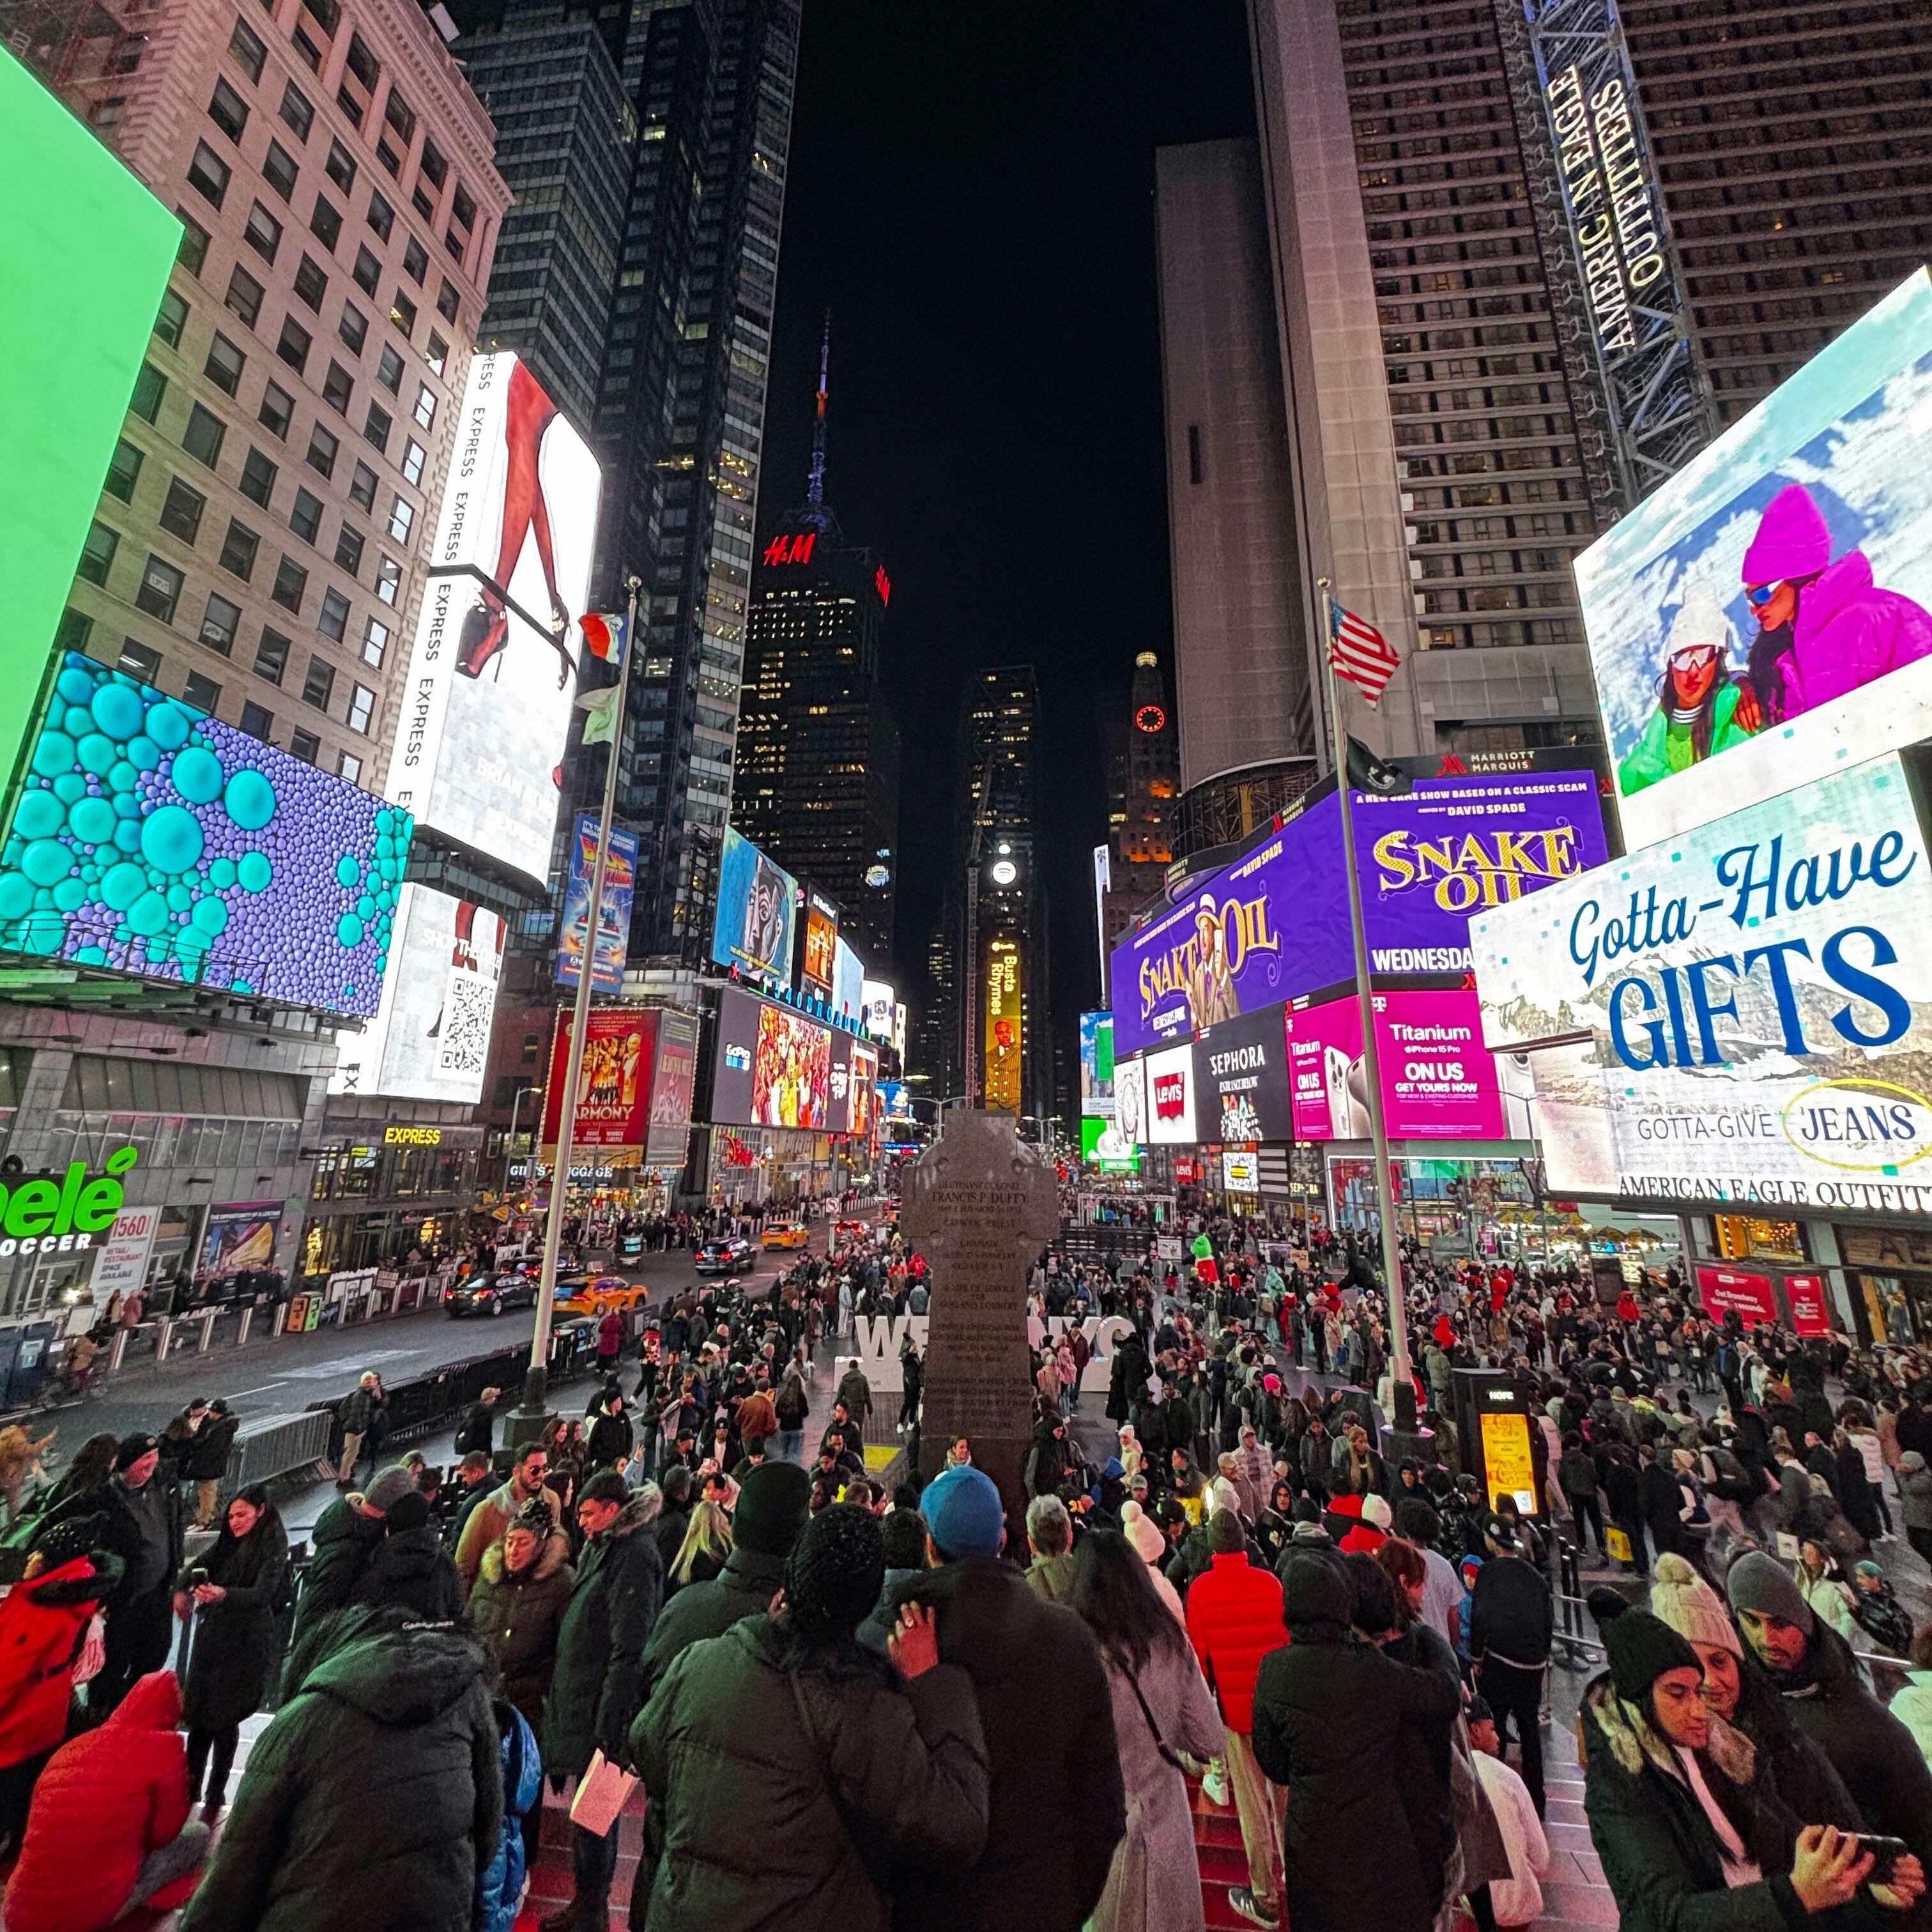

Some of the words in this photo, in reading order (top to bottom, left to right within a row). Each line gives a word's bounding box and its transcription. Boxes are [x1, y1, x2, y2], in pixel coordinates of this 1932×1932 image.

[1548, 65, 1595, 174] EAGLE
[1591, 79, 1664, 289] OUTFITTERS
[1568, 168, 1636, 352] AMERICAN
[460, 407, 485, 477] EXPRESS
[445, 492, 468, 560] EXPRESS
[763, 533, 815, 566] H&M
[425, 584, 451, 661] EXPRESS
[404, 678, 434, 767] EXPRESS
[1471, 751, 1535, 762] MARRIOTT
[1472, 760, 1529, 772] MARQUIS
[1421, 790, 1450, 800] SHOW
[1452, 789, 1485, 798] BASED
[1487, 788, 1500, 797] ON
[1503, 787, 1512, 795] A
[1514, 785, 1555, 795] CLASSIC
[1558, 783, 1587, 793] SCAM
[1448, 805, 1485, 816] DAVID
[1487, 803, 1526, 814] SPADE
[1243, 856, 1261, 878] DAVID
[1262, 841, 1283, 864] SPADE
[1373, 825, 1581, 893] SNAKE
[1140, 933, 1199, 1020] SNAKE
[1220, 894, 1278, 974] OIL
[988, 963, 1004, 1015] Rhymes
[1004, 956, 1018, 992] Busta
[763, 976, 803, 1008] 1540
[1609, 926, 1912, 1071] GIFTS
[1291, 1039, 1321, 1056] Titanium
[1389, 1024, 1471, 1041] Titanium
[1209, 1045, 1265, 1075] SEPHORA
[1406, 1062, 1435, 1080] ON
[1438, 1062, 1464, 1080] US
[1395, 1083, 1414, 1092] GET
[1416, 1083, 1450, 1092] YOURS
[1452, 1083, 1478, 1092] NOW
[573, 1106, 634, 1120] ARMONY
[1638, 1113, 1775, 1140] GOTTA-GIVE
[1801, 1105, 1915, 1140] JEANS
[385, 1127, 441, 1145] EXPRESS
[933, 1192, 977, 1202] FRANCIS
[992, 1193, 1027, 1204] DUFFY
[1620, 1176, 1724, 1202] AMERICAN
[1731, 1179, 1809, 1206] EAGLE
[112, 1215, 146, 1237] 1560
